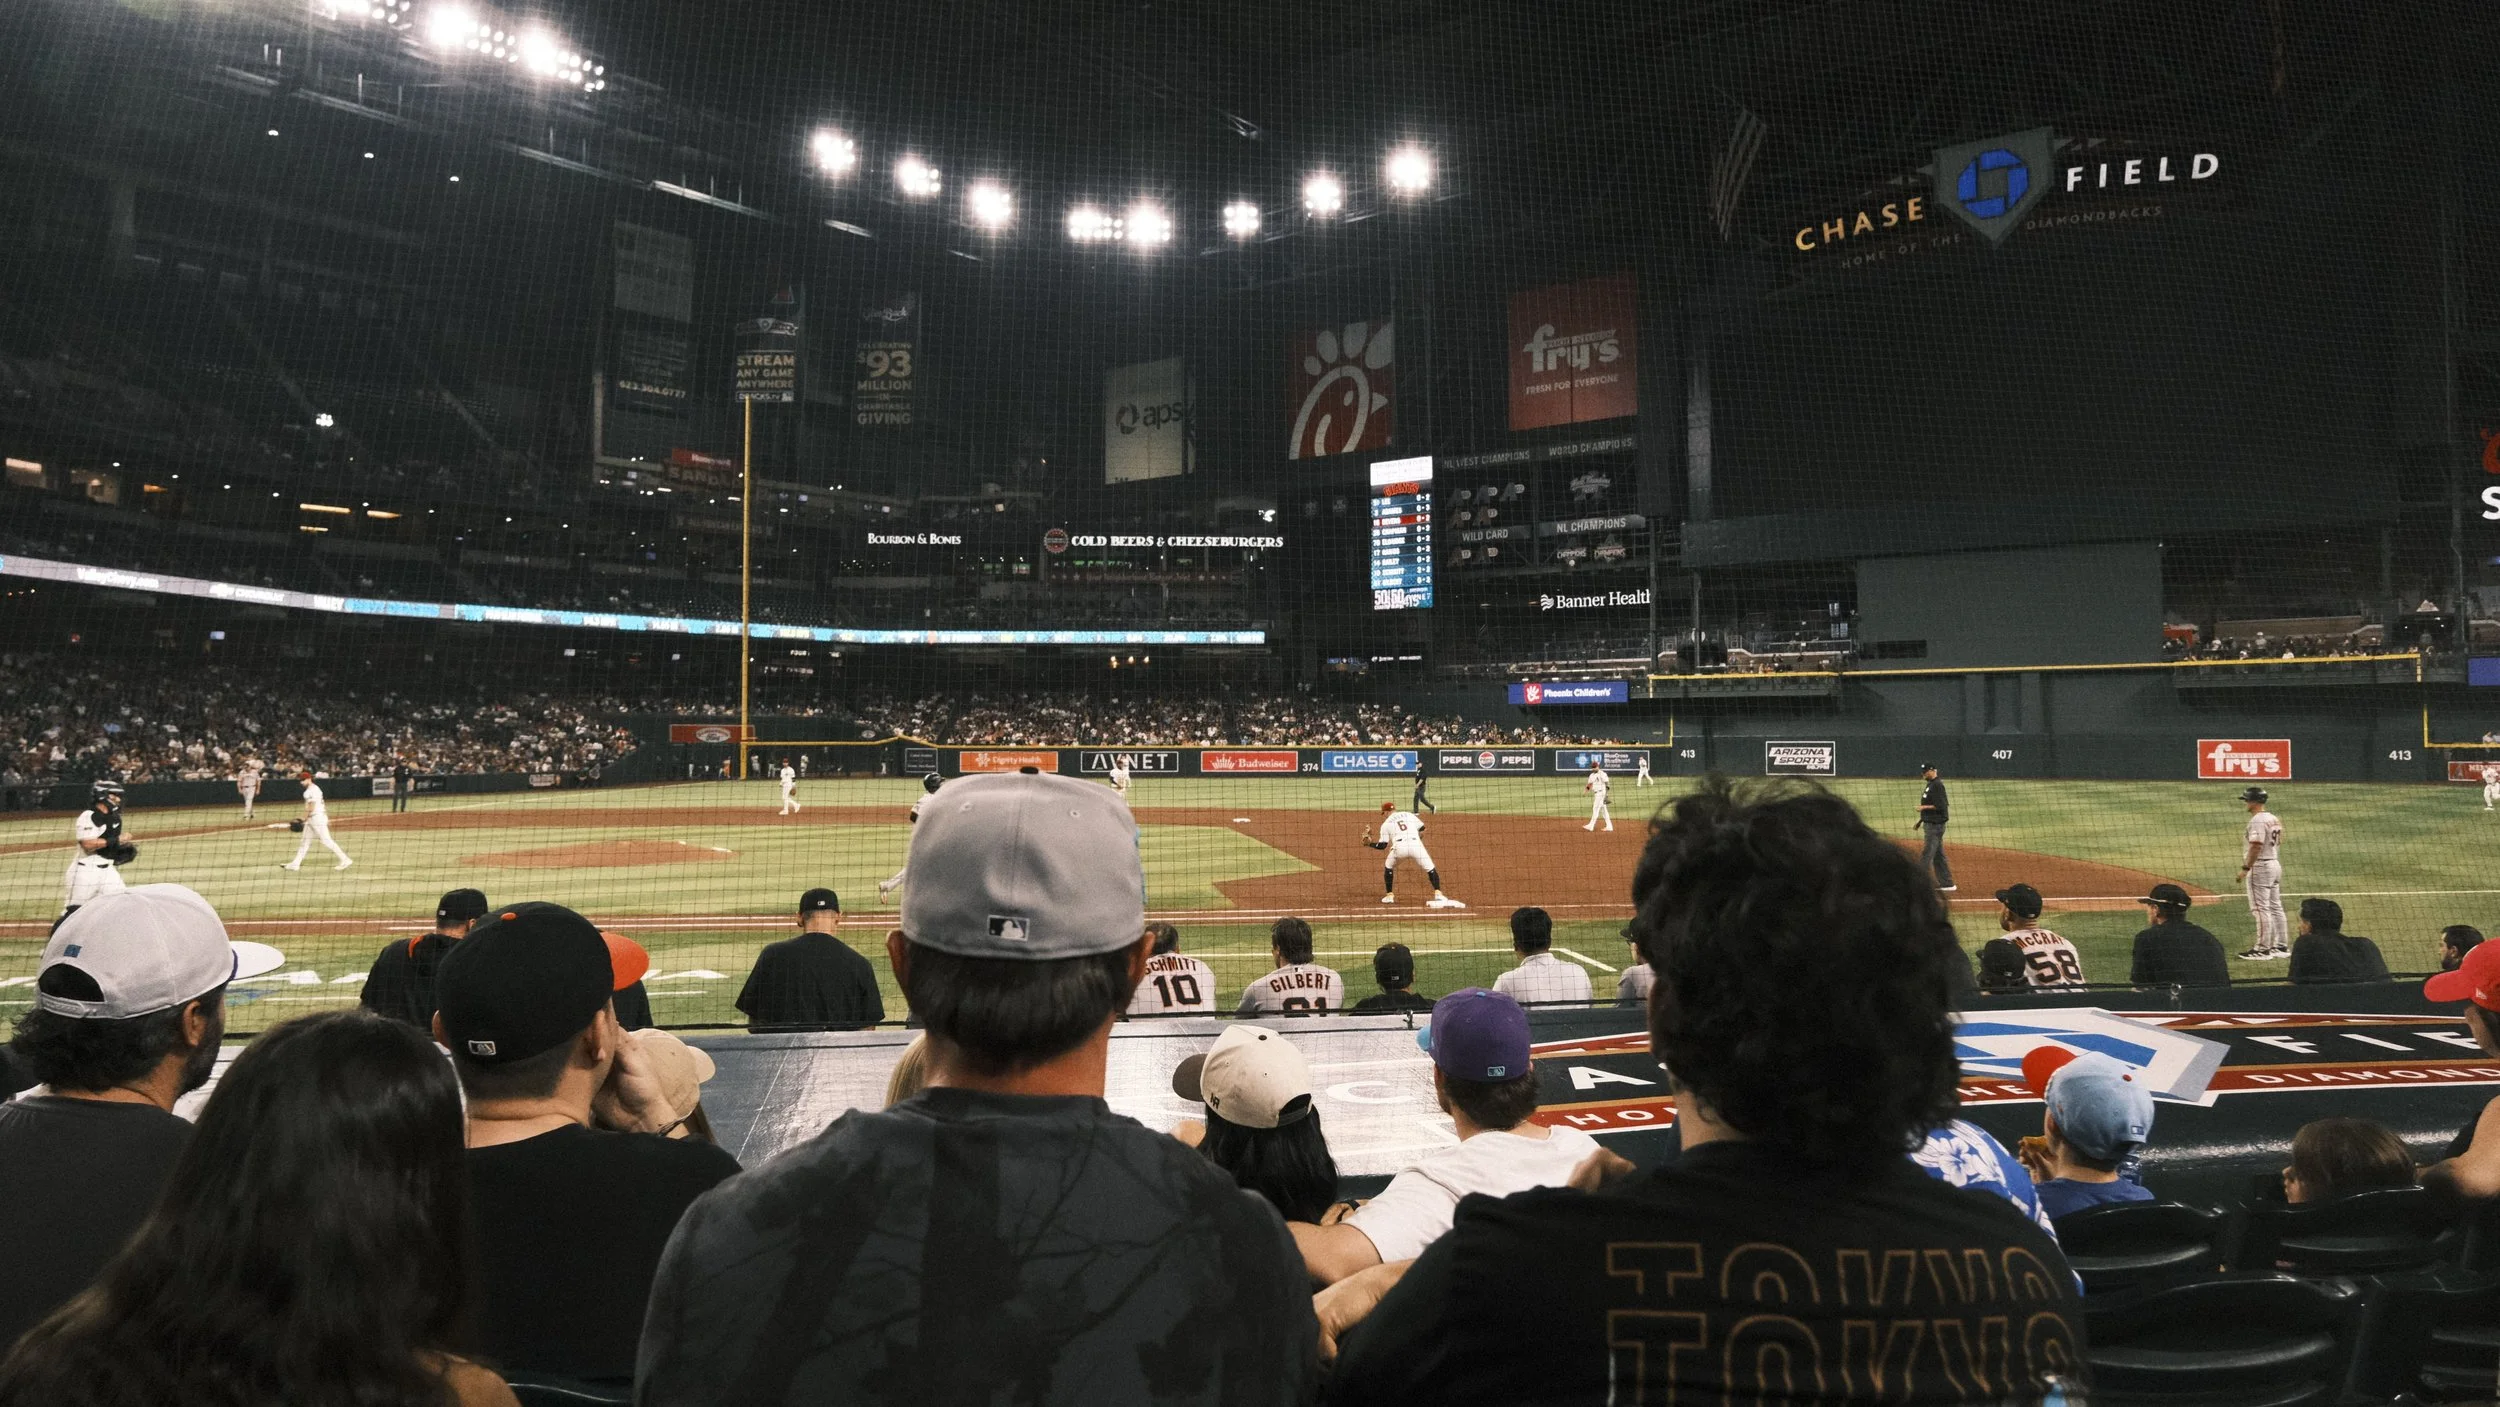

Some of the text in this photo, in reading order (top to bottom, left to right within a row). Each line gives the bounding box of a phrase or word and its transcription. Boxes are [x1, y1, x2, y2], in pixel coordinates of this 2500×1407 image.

[1795, 152, 2220, 251] CHASE FIELD
[1842, 205, 2162, 269] HOME OF THE DIAMONDBACKS
[1523, 323, 1620, 373] fry's
[736, 355, 795, 366] STREAM
[736, 368, 795, 378] ANY GAME
[736, 380, 795, 389] ANYWHERE
[857, 380, 912, 391] MILLION
[1525, 374, 1619, 396] FRESH FOR EVERYONE
[857, 412, 912, 425] GIVING
[1143, 402, 1184, 430] aps
[1548, 437, 1633, 457] WORLD CHAMPIONS
[1481, 450, 1530, 464] CHAMPIONS
[1556, 517, 1627, 533] NL CHAMPIONS
[917, 533, 928, 544] &
[1071, 535, 1108, 547] COLD
[1110, 535, 1154, 547] BEERS
[1156, 537, 1165, 547] &
[1167, 536, 1284, 548] CHEESEBURGERS
[1462, 528, 1509, 542] WILD CARD
[1556, 595, 1606, 609] Banner
[1544, 688, 1573, 698] Phoenix
[992, 756, 1043, 765] Dignity Health
[1442, 756, 1473, 765] PEPSI
[1502, 756, 1532, 765] PEPSI
[1680, 749, 1696, 759] 413
[1779, 756, 1826, 764] SPORTS
[1992, 749, 2013, 760] 407
[2206, 742, 2280, 775] fry's
[2389, 750, 2412, 761] 413
[1091, 753, 1169, 770] AVNET
[1238, 758, 1290, 768] Budweiser
[1302, 762, 1319, 772] 374
[1333, 755, 1389, 768] CHASE
[1397, 820, 1407, 831] 6
[2025, 949, 2083, 983] 58
[1270, 973, 1331, 993] GILBERT
[1153, 974, 1203, 1007] 10
[1956, 1084, 2034, 1097] HE
